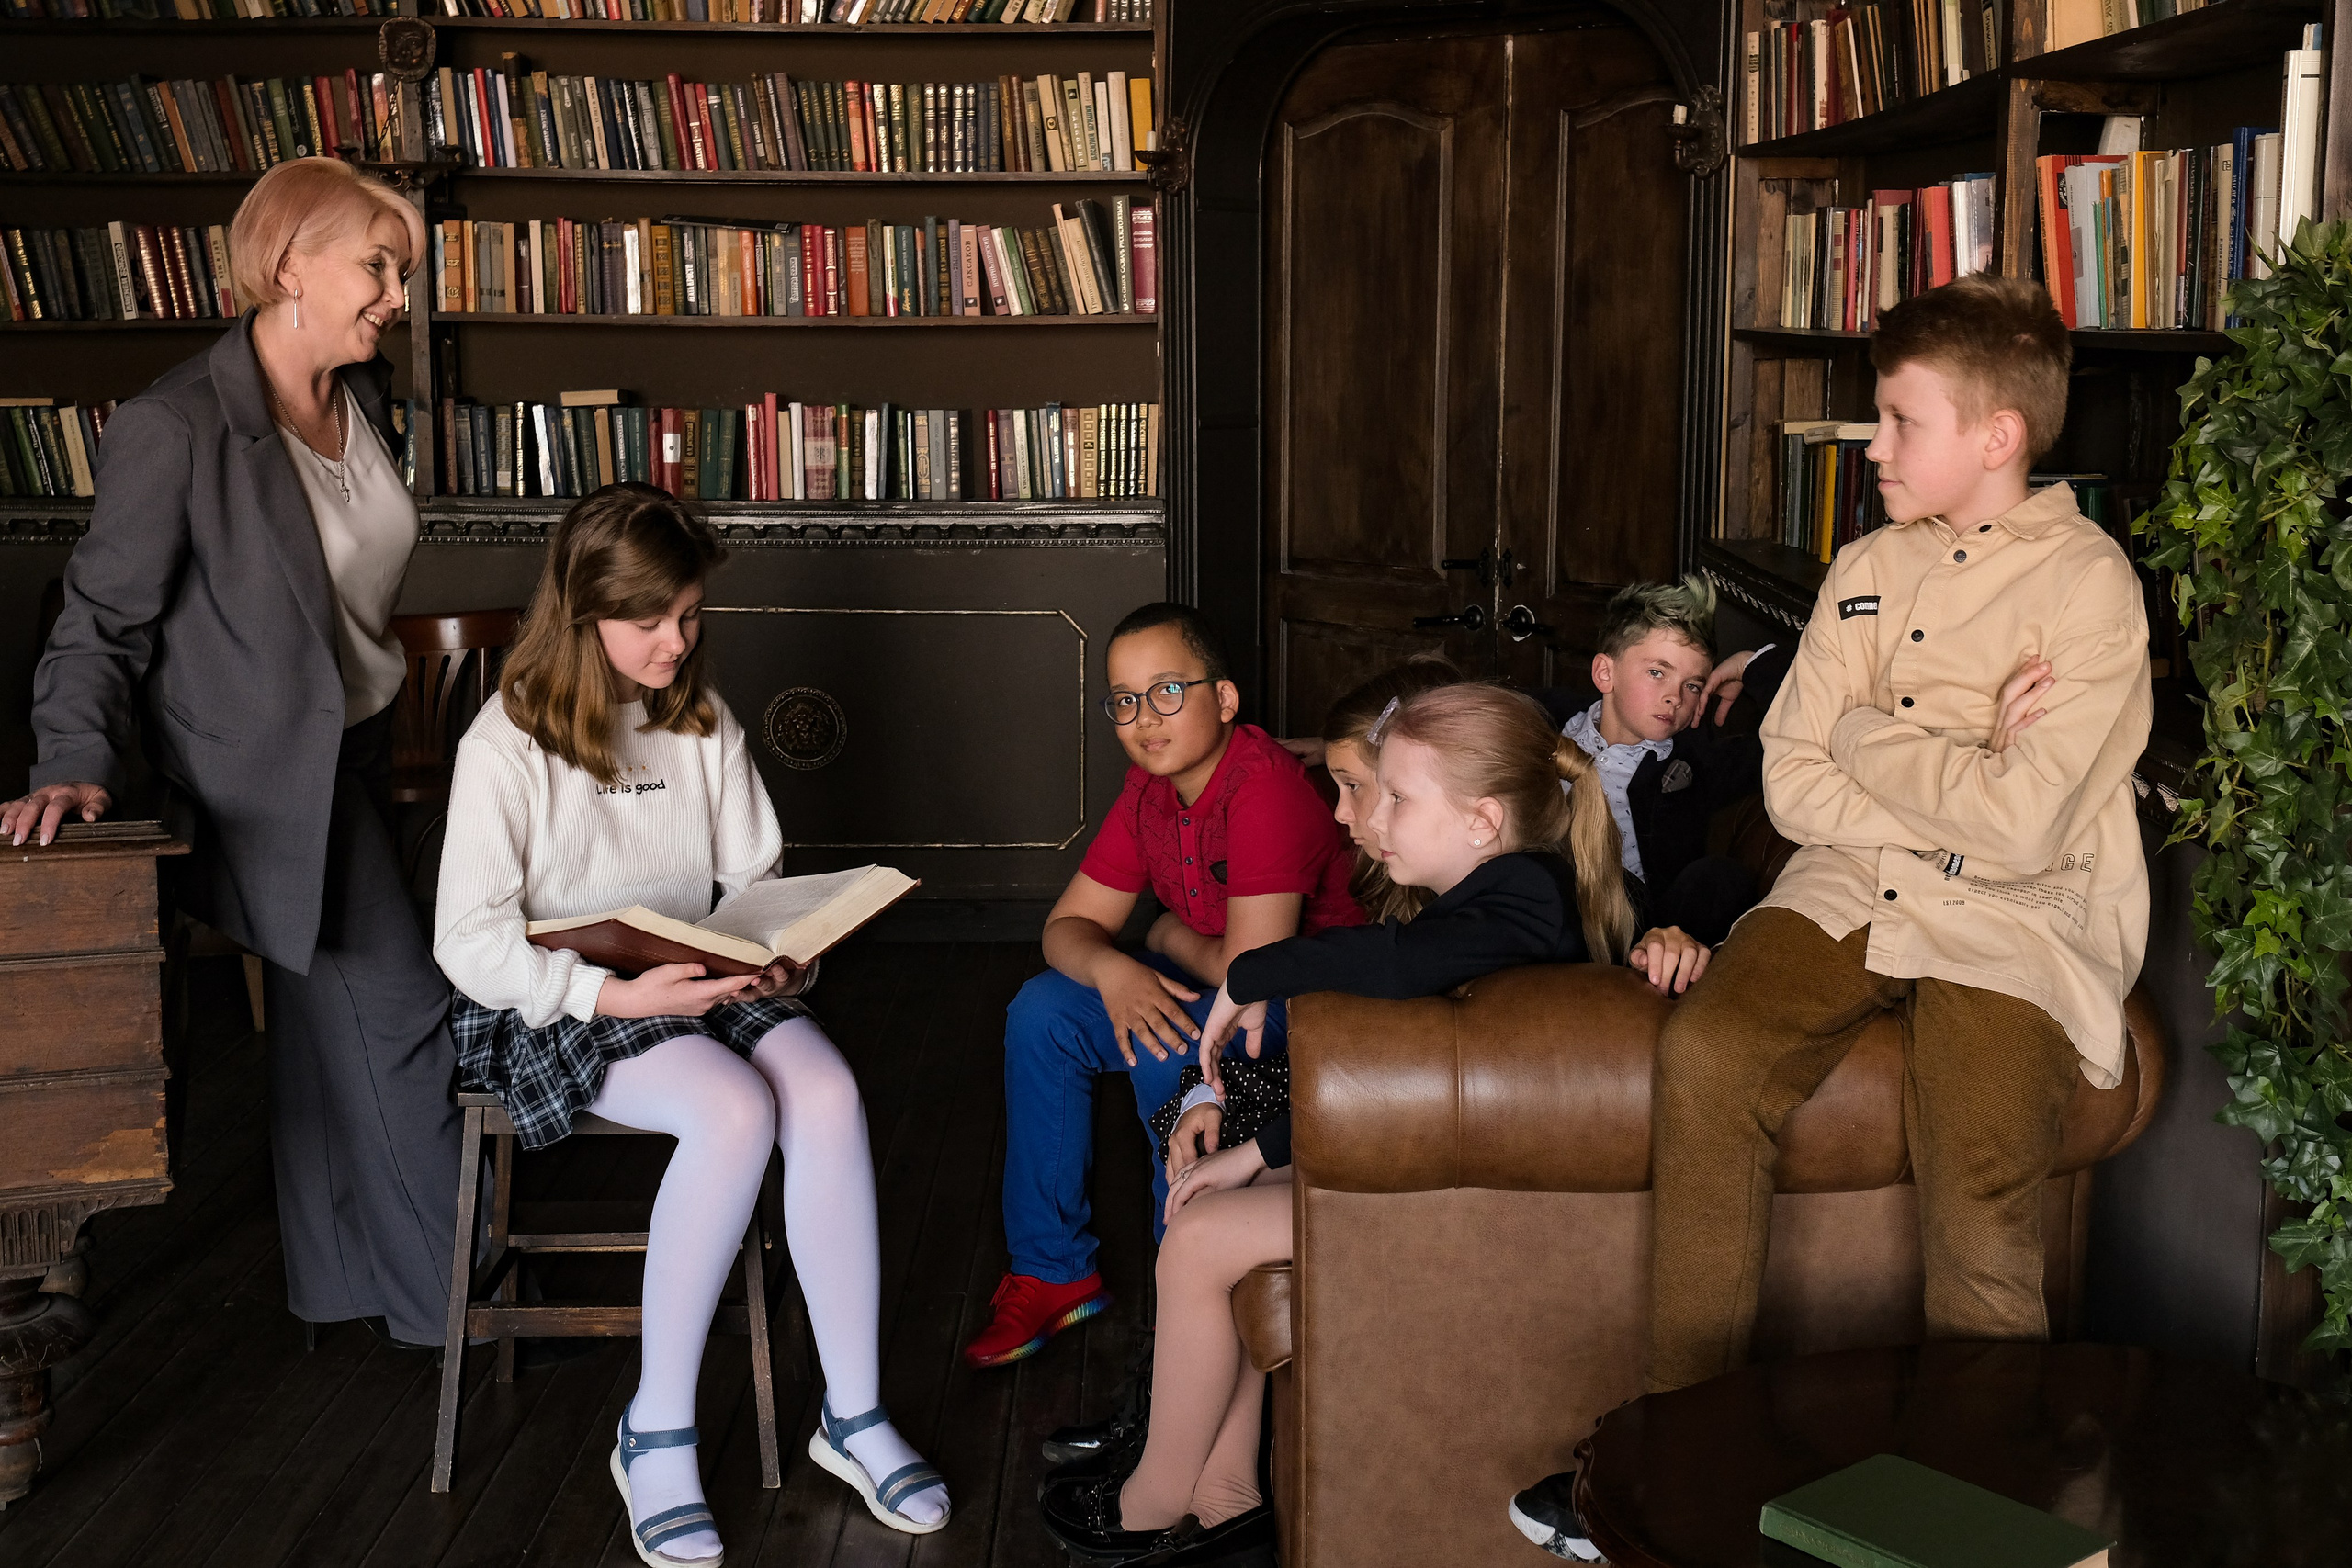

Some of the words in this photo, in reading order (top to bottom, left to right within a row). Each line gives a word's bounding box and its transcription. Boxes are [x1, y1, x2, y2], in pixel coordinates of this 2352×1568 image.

[1121, 11, 1127, 20] 2
[1134, 10, 1140, 18] 4
[698, 98, 707, 125] КПСС
[911, 94, 920, 131] СПАРТАК
[1084, 104, 1095, 131] ШУКШИН
[1076, 240, 1089, 267] болезни
[1083, 267, 1098, 311] Тропические
[621, 783, 631, 794] is
[635, 779, 666, 795] good
